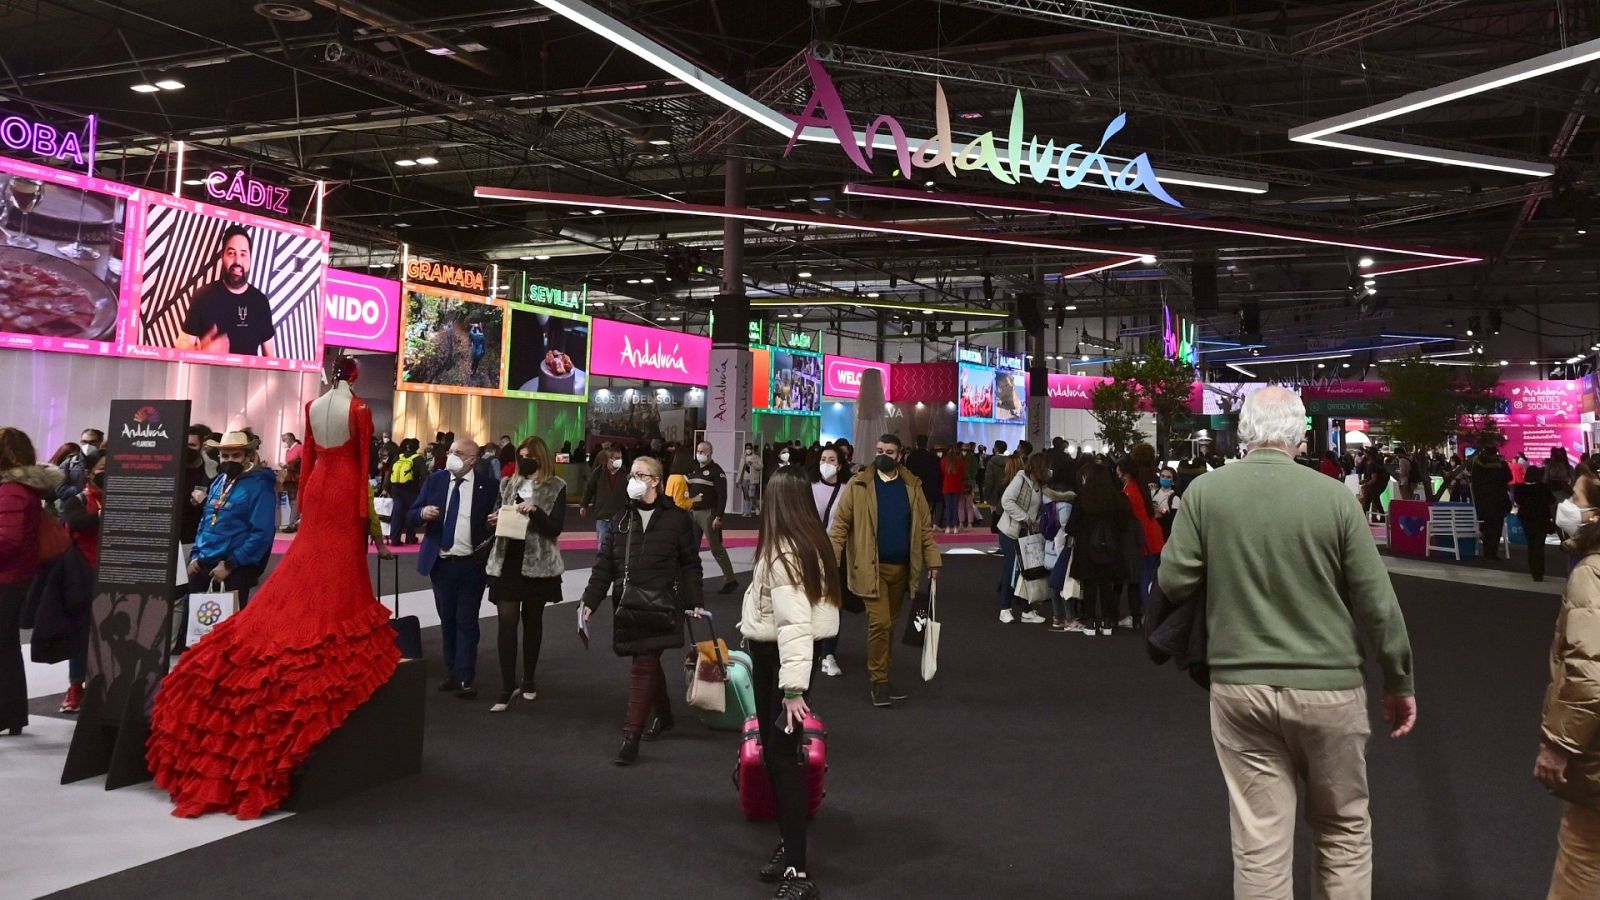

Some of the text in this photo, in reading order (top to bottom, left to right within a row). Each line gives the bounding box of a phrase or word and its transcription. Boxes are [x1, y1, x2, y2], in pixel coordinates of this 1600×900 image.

[1, 116, 84, 165] OBA
[784, 52, 1184, 208] Andalucía
[206, 170, 290, 214] CÁDIZ
[408, 258, 485, 291] GRANADA
[325, 294, 379, 325] NIDO
[530, 284, 579, 309] SEVILLA
[620, 334, 689, 374] Andalucía
[594, 394, 629, 404] COSTA
[632, 394, 652, 405] DEL
[657, 394, 678, 405] SOL
[713, 357, 729, 423] Andalucía
[1048, 384, 1088, 400] ndalucía
[121, 423, 169, 439] Andalucía
